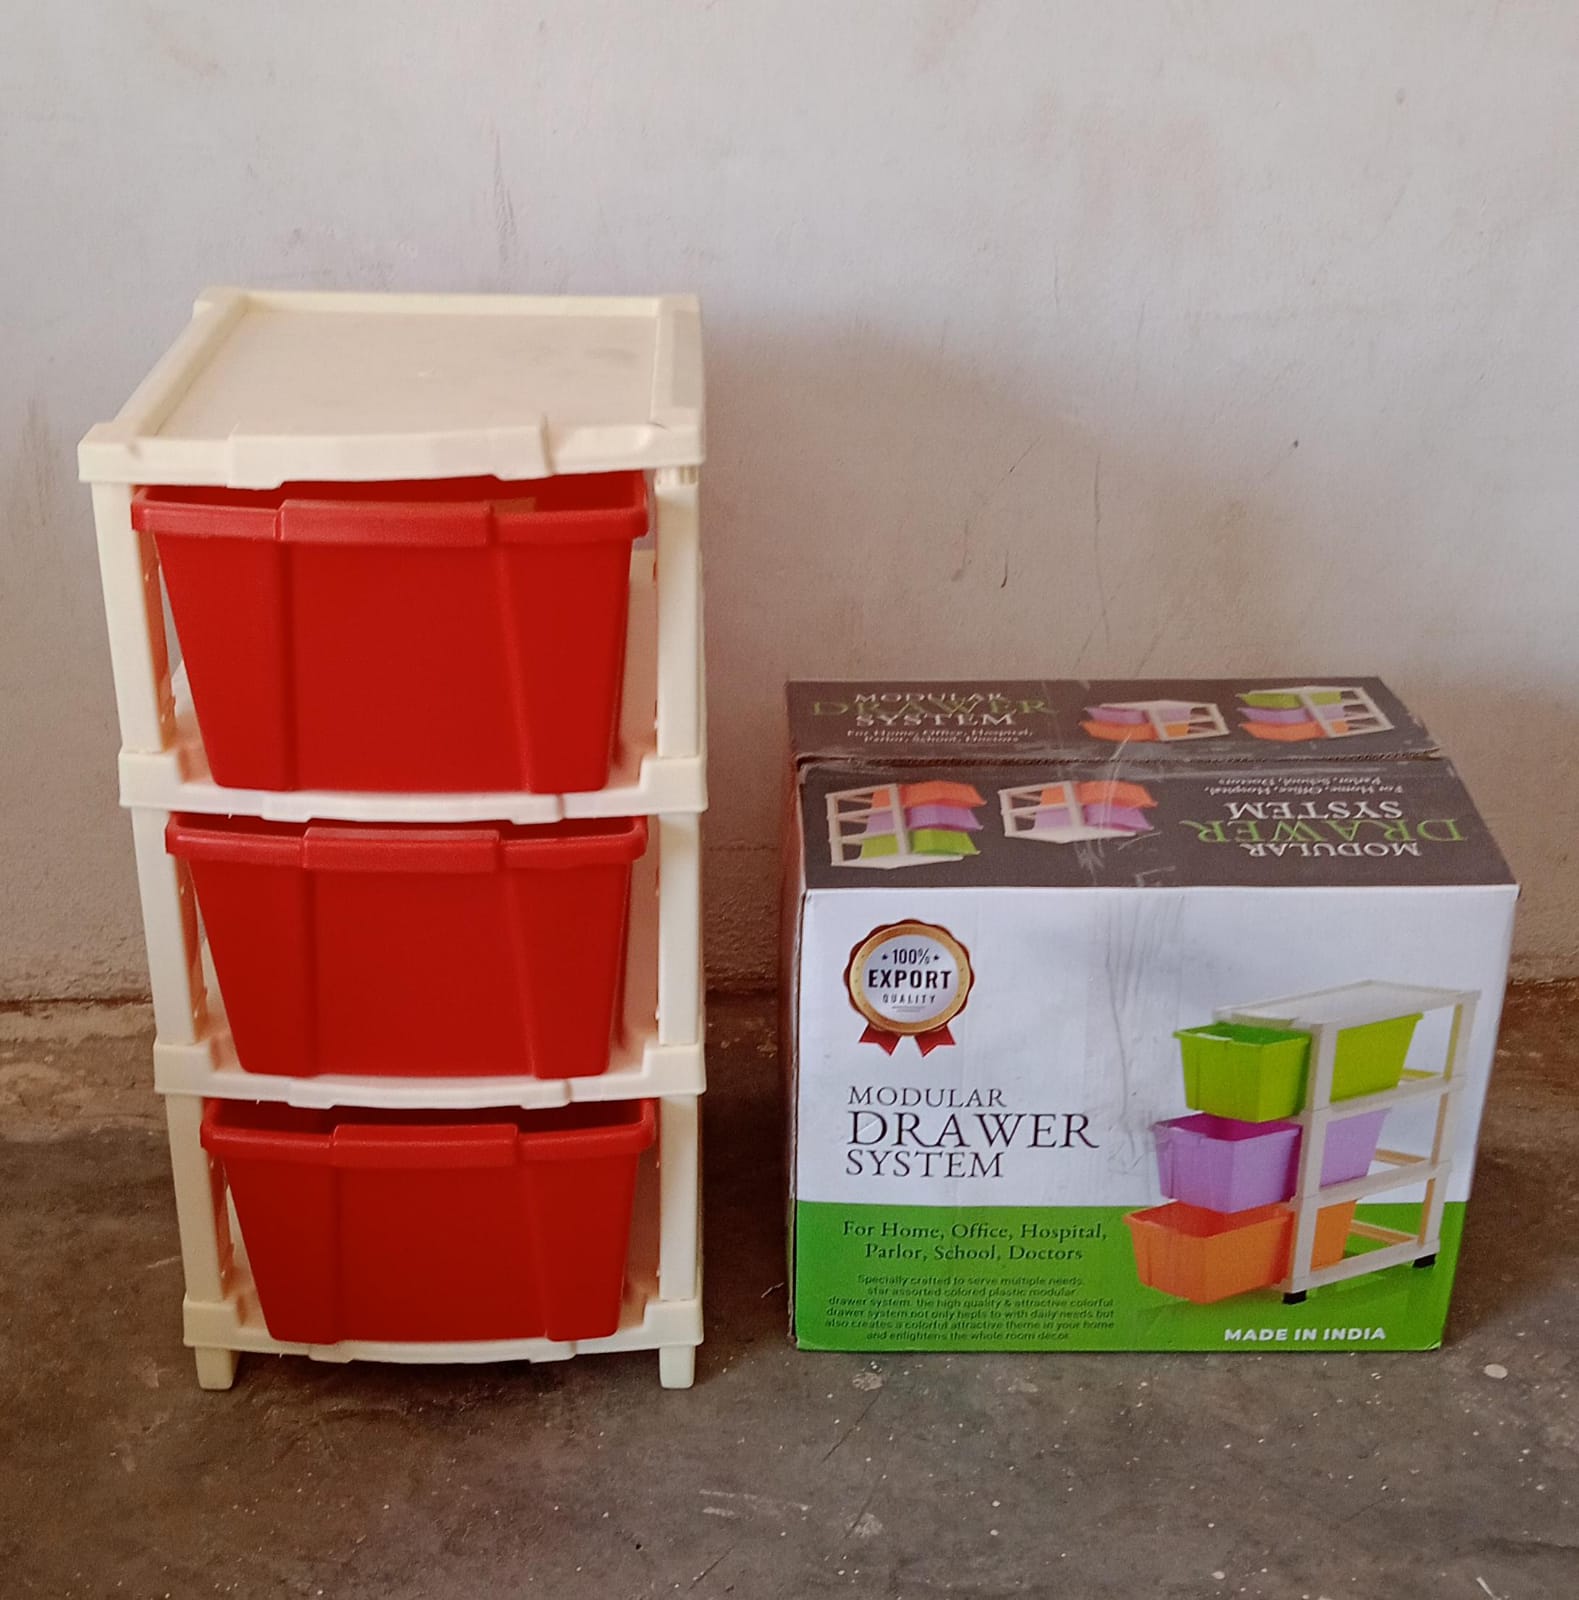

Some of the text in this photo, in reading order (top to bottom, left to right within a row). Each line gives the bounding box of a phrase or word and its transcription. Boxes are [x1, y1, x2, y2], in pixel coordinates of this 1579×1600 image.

[857, 713, 1016, 726] SYSTEM
[1224, 801, 1403, 819] SYSTEM
[1179, 819, 1467, 843] DRAWER
[1240, 842, 1423, 857] MODULAR
[892, 948, 930, 965] 100%
[868, 969, 952, 989] EXPORT
[883, 993, 936, 1004] QUALITY
[848, 1086, 1007, 1108] MODULAR
[847, 1110, 1100, 1149] DRAWER
[845, 1149, 1004, 1178] SYSTEM
[843, 1220, 1107, 1243] For Home, Office, Hospital,
[865, 1243, 1082, 1262] Parlor, School, Doctors
[857, 1274, 909, 1287] Specially
[910, 1276, 951, 1286] crafted
[953, 1276, 966, 1285] to
[1000, 1276, 1046, 1287] multiple
[892, 1287, 941, 1297] assorted
[944, 1287, 986, 1297] colored
[989, 1287, 1026, 1298] plastic
[1028, 1287, 1077, 1297] modular
[828, 1296, 867, 1306] drawer
[936, 1299, 961, 1309] high
[963, 1299, 1002, 1309] quality
[1003, 1299, 1012, 1307] &
[1014, 1299, 1068, 1308] attractive
[1070, 1298, 1114, 1308] colorful
[826, 1307, 865, 1317] drawer
[867, 1309, 908, 1320] system
[910, 1310, 928, 1318] not
[931, 1309, 955, 1320] only
[989, 1309, 1001, 1318] to
[1004, 1309, 1028, 1318] with
[1030, 1309, 1058, 1320] daily
[1060, 1309, 1093, 1318] needs
[1095, 1309, 1114, 1318] but
[824, 1318, 849, 1328] also
[851, 1320, 892, 1329] creates
[905, 1320, 948, 1330] colorful
[950, 1320, 1004, 1330] attractive
[1006, 1320, 1041, 1329] theme
[1043, 1320, 1053, 1329] in
[1055, 1321, 1081, 1331] your
[1083, 1320, 1115, 1329] home
[866, 1331, 888, 1340] and
[950, 1331, 968, 1340] the
[970, 1331, 1003, 1340] whole
[1005, 1332, 1036, 1341] room
[1224, 1327, 1386, 1341] MADE IN INDIA
